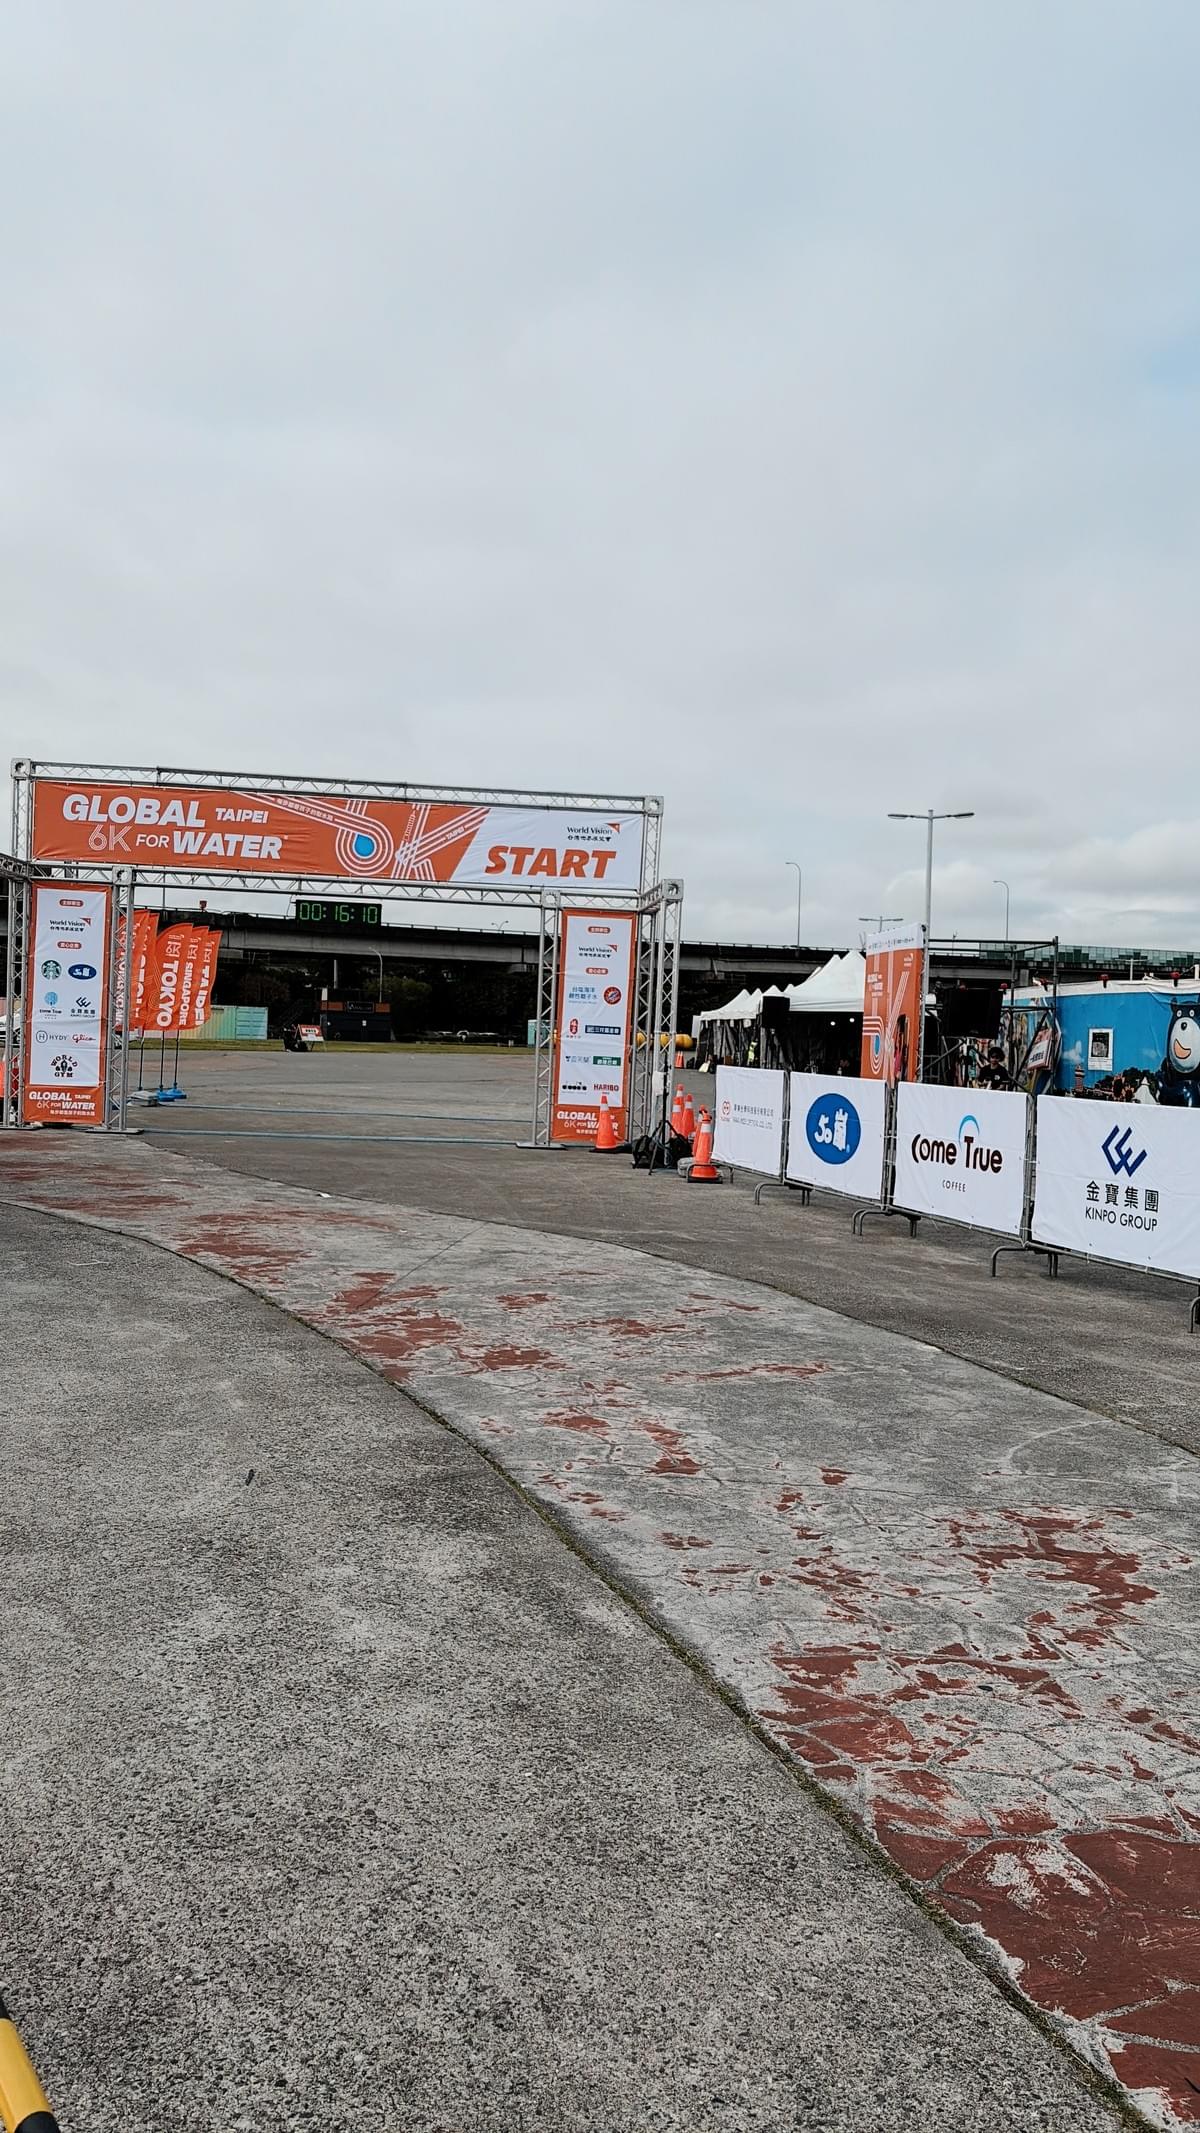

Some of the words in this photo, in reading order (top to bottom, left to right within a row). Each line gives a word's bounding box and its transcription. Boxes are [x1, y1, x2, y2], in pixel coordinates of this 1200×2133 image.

[62, 793, 206, 828] GLOBAL
[215, 807, 269, 823] TAIPEI
[88, 824, 133, 852] 6K
[136, 834, 169, 848] FOR
[173, 830, 282, 859] WATER
[567, 826, 589, 834] World
[591, 827, 613, 835] Vision
[485, 845, 617, 879] START
[300, 902, 378, 924] 00:16:10
[157, 960, 179, 1027] TOKYO
[179, 961, 194, 1026] SINGAPORE
[72, 1034, 96, 1043] Glico
[51, 1055, 78, 1067] WORLD
[29, 1091, 72, 1101] GLOBAL
[594, 1084, 619, 1092] HARIBO
[37, 1101, 50, 1109] 6K
[62, 1101, 95, 1110] WATER
[557, 1111, 597, 1120] GLOBAL
[911, 1133, 956, 1165] Come
[964, 1136, 1003, 1173] True
[942, 1180, 966, 1193] COFFEE
[1086, 1181, 1159, 1213] 金寶集團
[1085, 1206, 1117, 1224] KINPO
[1119, 1213, 1158, 1231] GROUP
